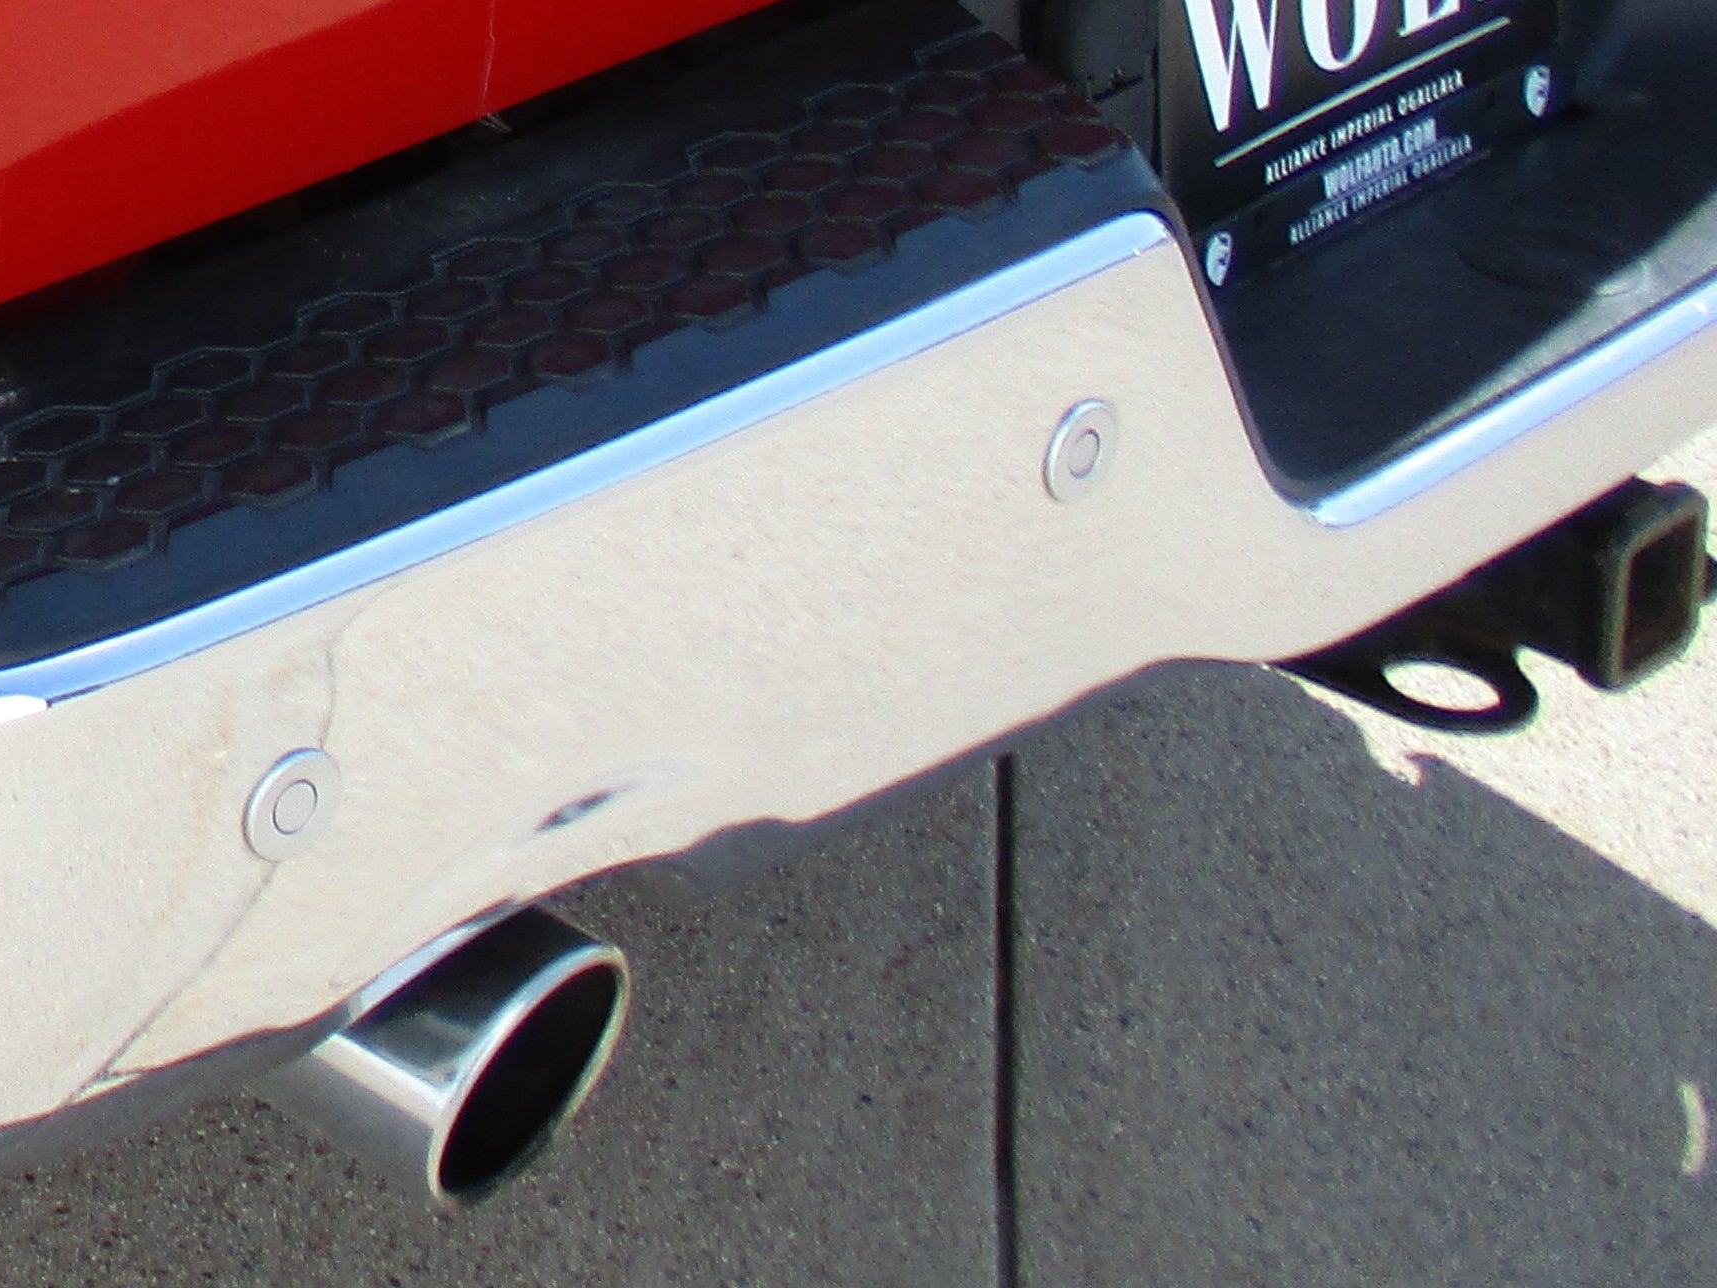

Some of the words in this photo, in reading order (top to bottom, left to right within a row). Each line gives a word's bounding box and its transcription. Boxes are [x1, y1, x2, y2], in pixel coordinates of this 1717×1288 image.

[1265, 133, 1328, 186] ALLIANCE
[1330, 103, 1394, 151] IMPERIAL
[1397, 68, 1464, 116] OGALLALA
[1289, 200, 1348, 246] ALLIANCE
[1351, 168, 1408, 212] IMPERIAL
